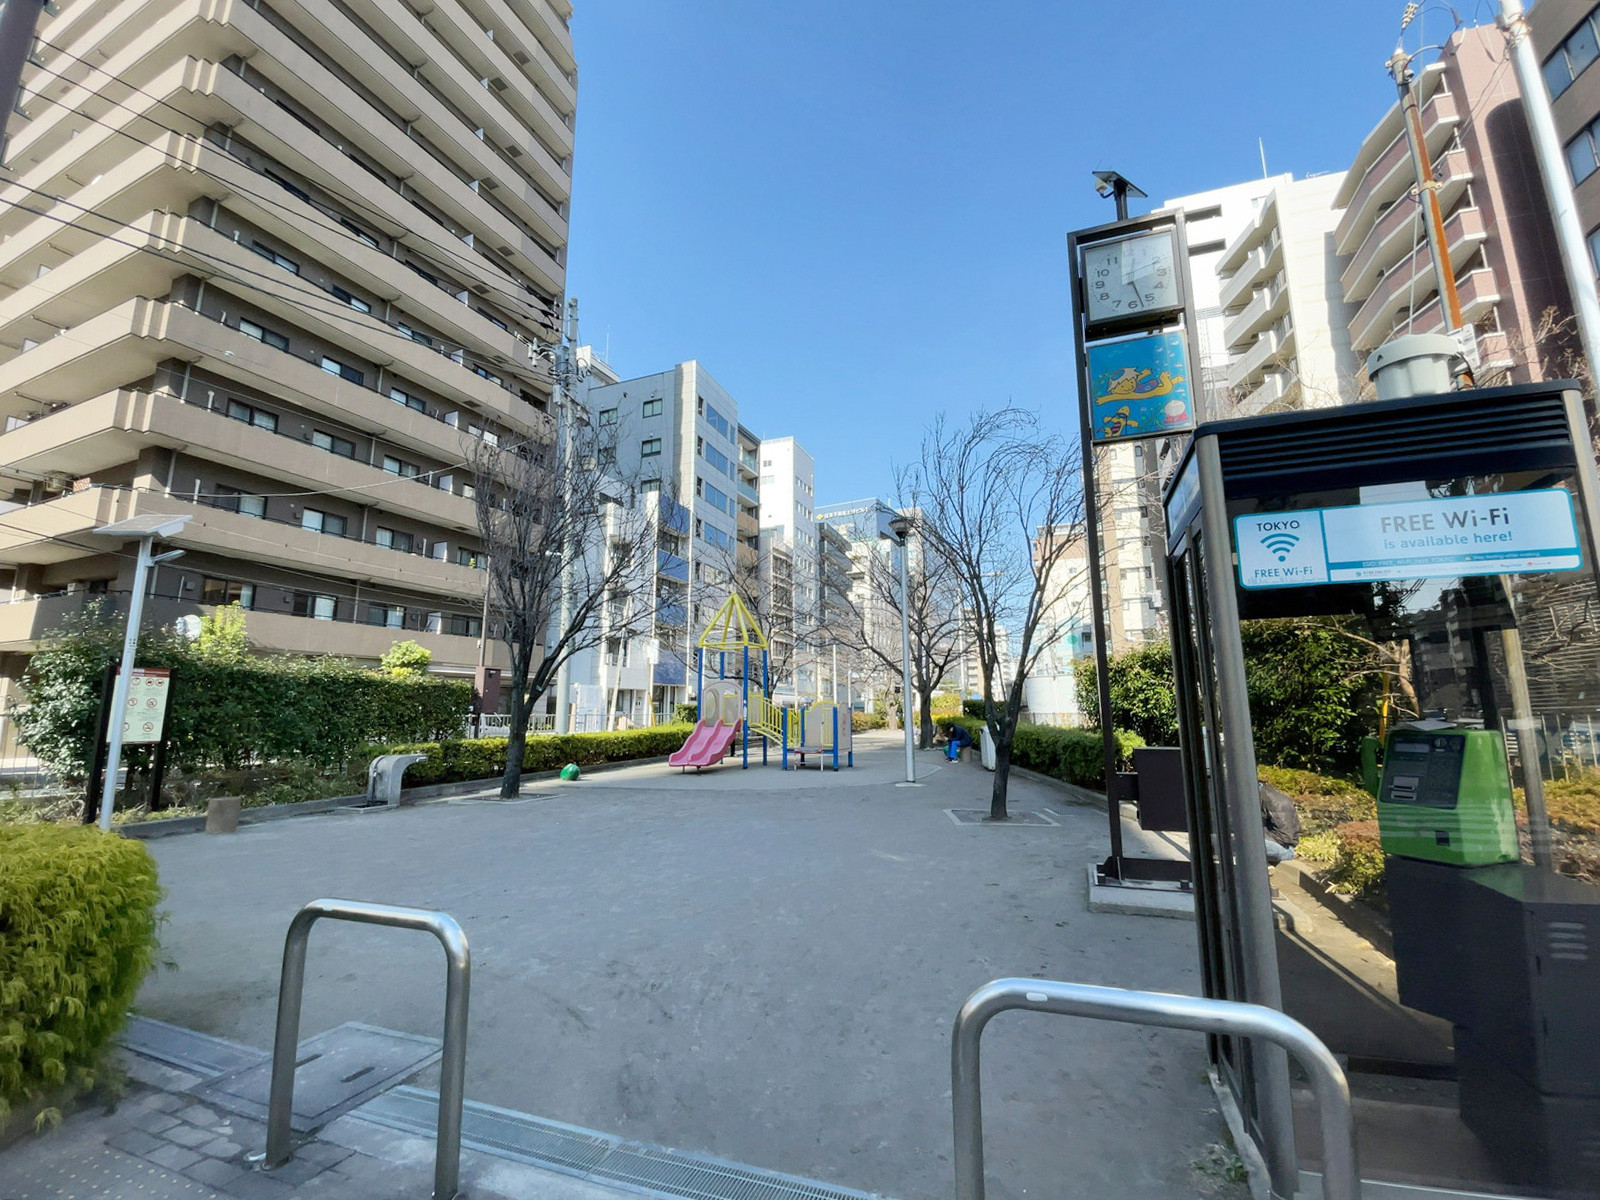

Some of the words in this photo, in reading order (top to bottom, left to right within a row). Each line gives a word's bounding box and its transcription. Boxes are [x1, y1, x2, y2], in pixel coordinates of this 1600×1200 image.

[1107, 256, 1117, 265] 11
[1097, 269, 1109, 277] 10
[1157, 268, 1167, 276] 3
[1145, 293, 1155, 301] 5
[1112, 300, 1121, 308] 7
[1380, 512, 1434, 534] FREE
[1442, 507, 1510, 531] Wi-Fi
[1256, 519, 1301, 532] TOKYO
[1384, 538, 1397, 550] is
[1400, 533, 1469, 549] available
[1473, 530, 1513, 544] here!
[1254, 568, 1280, 578] FREE
[1282, 565, 1313, 577] Wi-Fi
